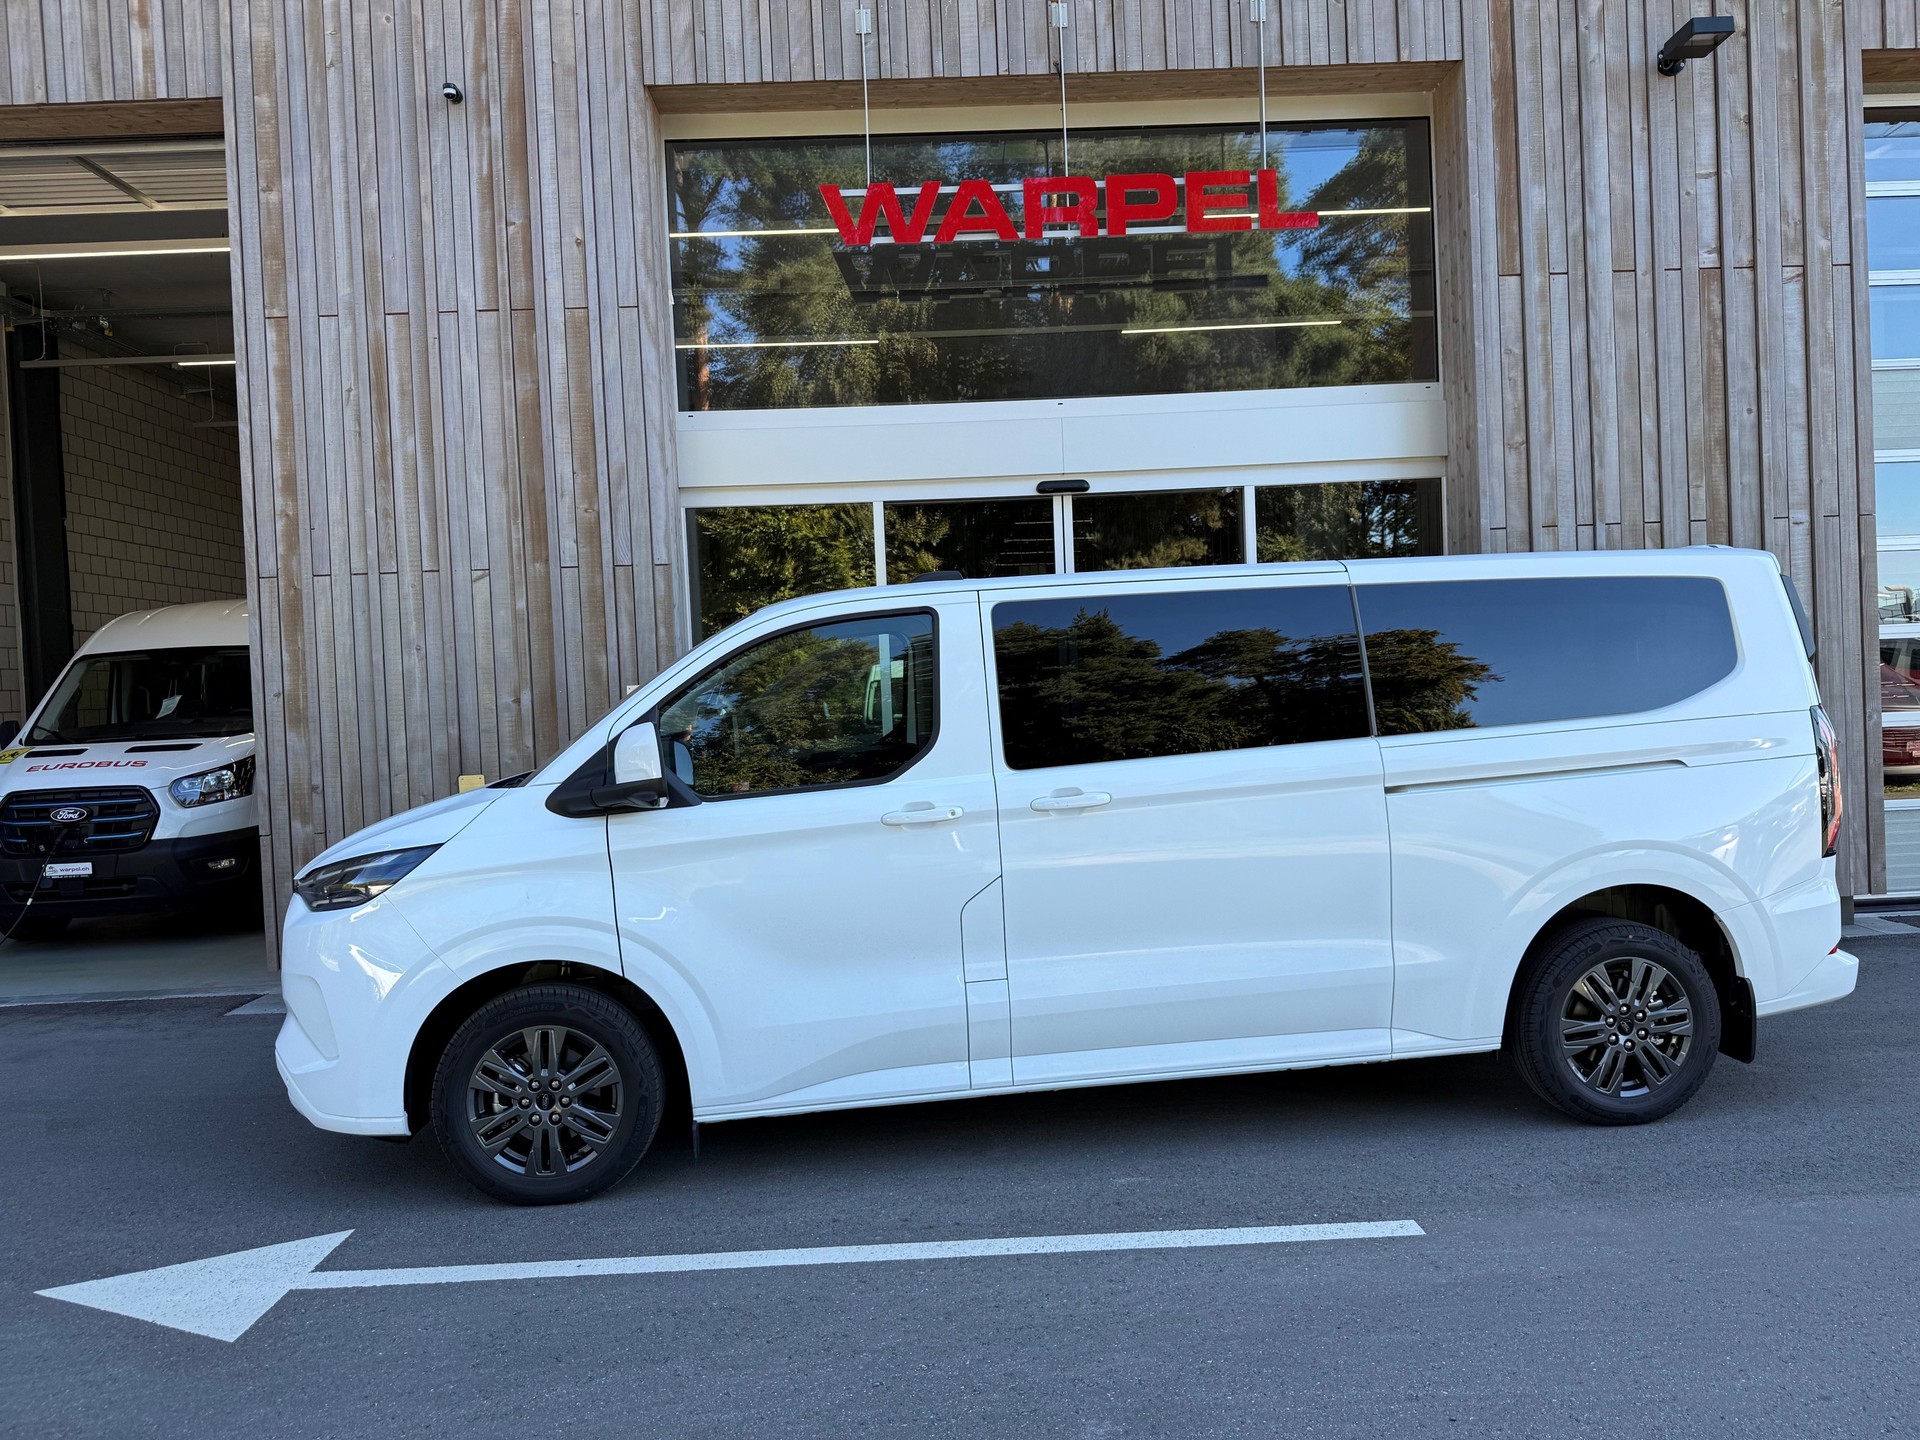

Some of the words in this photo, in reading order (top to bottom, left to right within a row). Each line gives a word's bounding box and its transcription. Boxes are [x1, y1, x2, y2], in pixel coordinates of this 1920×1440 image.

[819, 169, 1319, 246] WARPEL
[26, 760, 149, 772] EUROBUS
[56, 809, 80, 819] Ford
